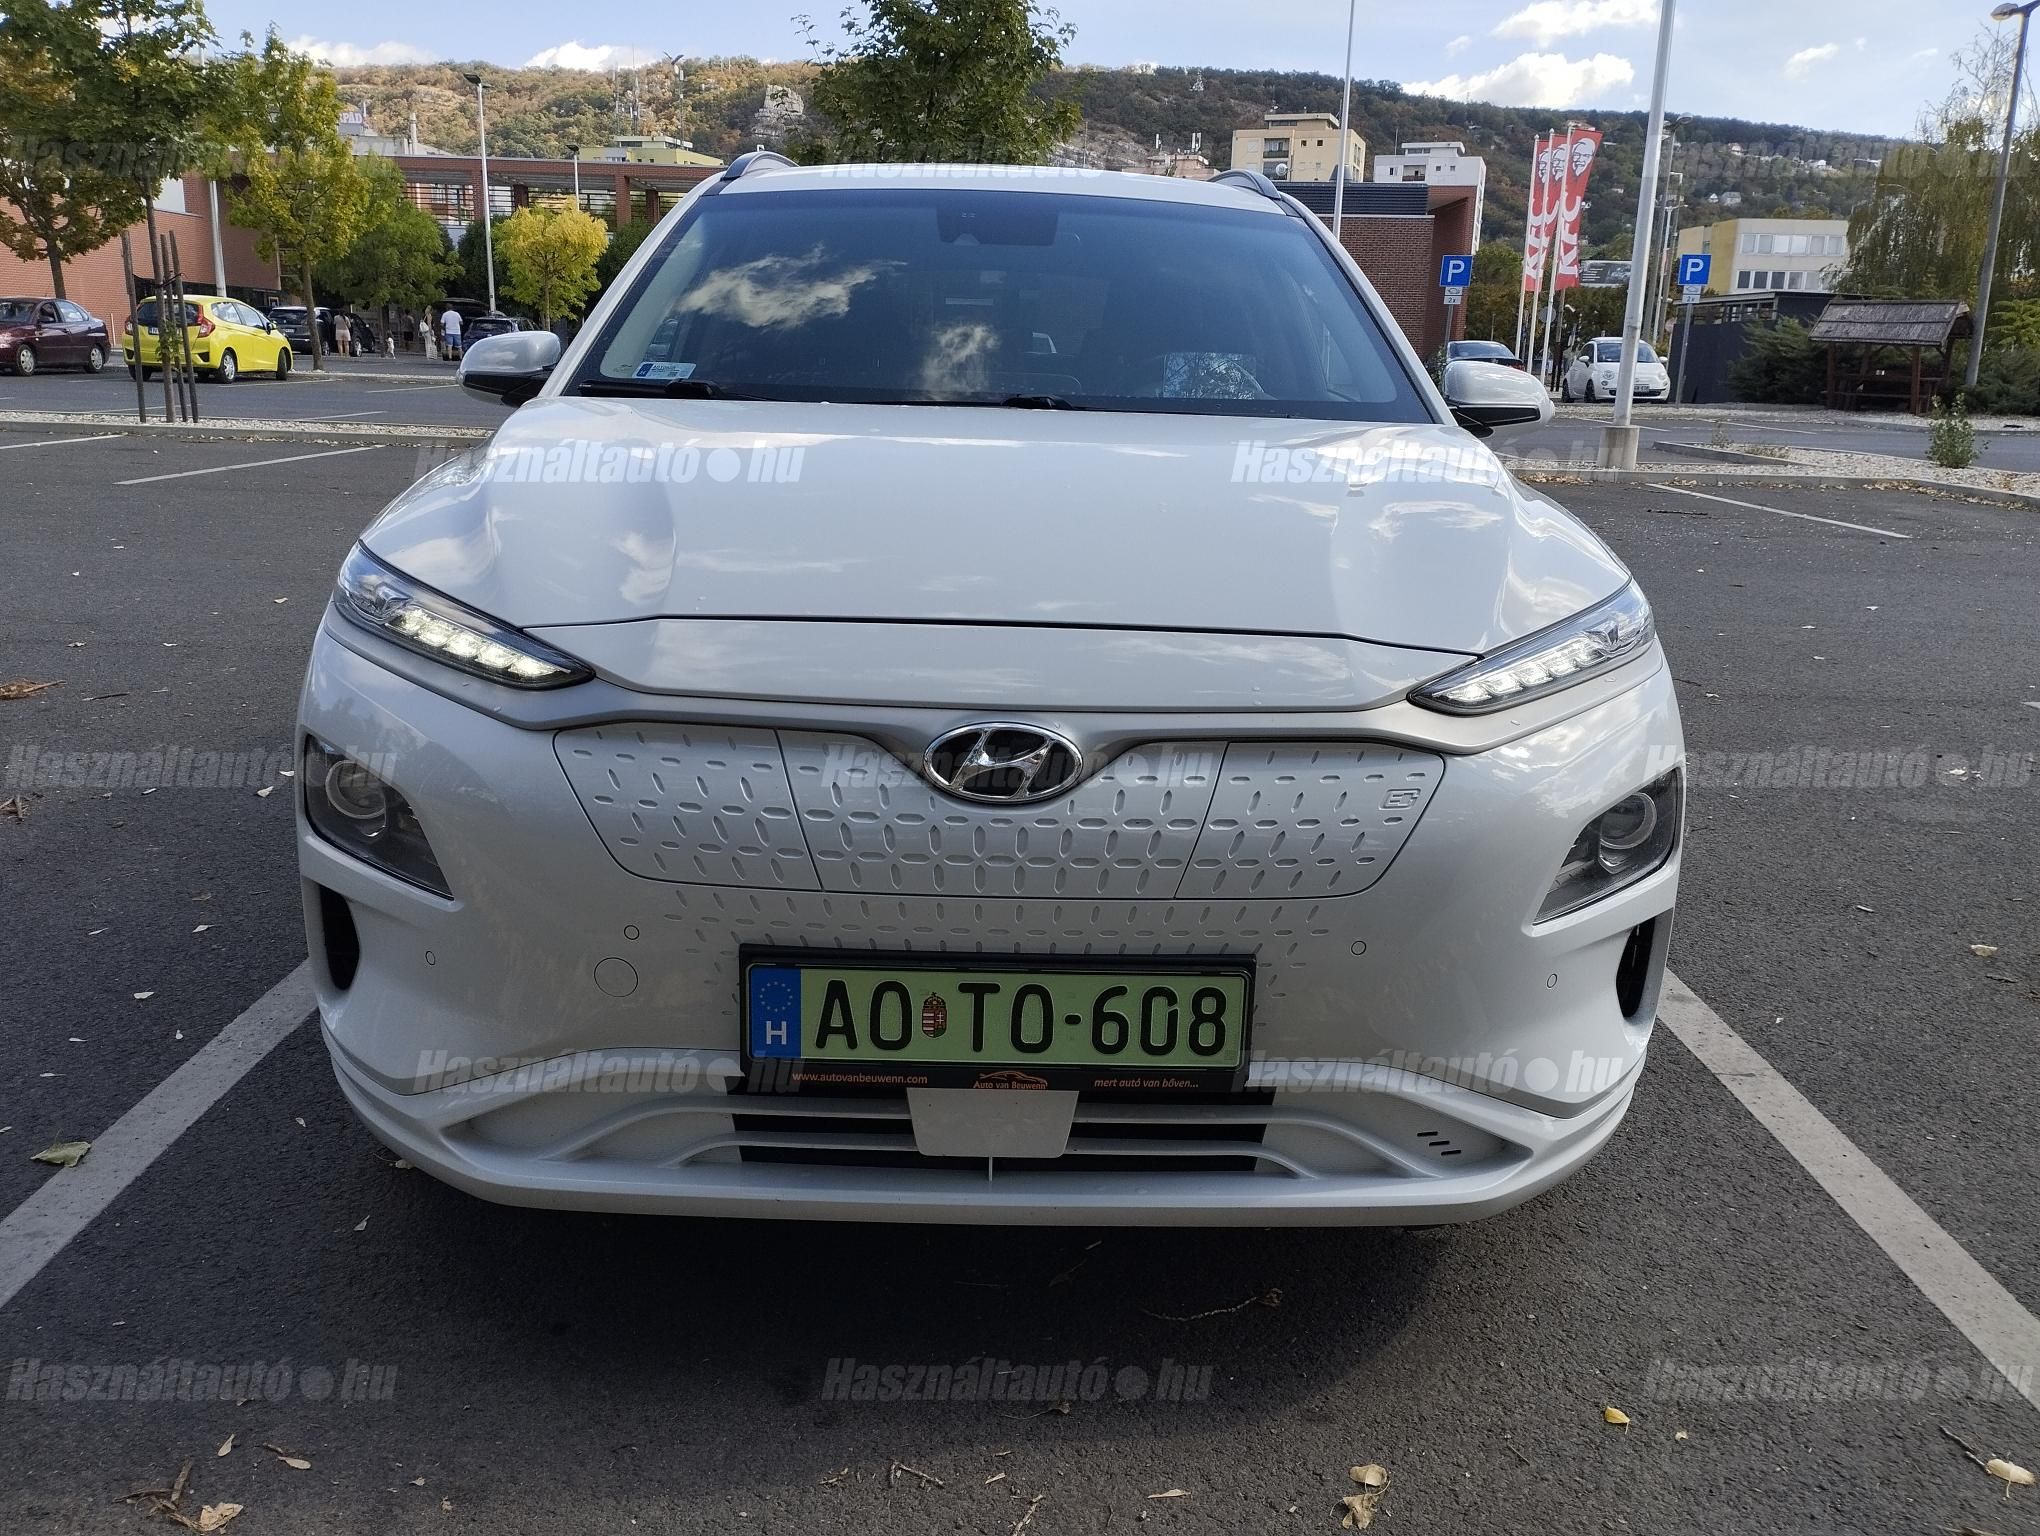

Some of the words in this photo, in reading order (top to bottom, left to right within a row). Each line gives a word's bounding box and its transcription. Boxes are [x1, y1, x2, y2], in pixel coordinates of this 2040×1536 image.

[1558, 191, 1582, 278] KFC
[1447, 260, 1465, 283] P
[1685, 258, 1704, 281] P
[815, 979, 914, 1051] AO
[765, 1020, 787, 1046] H
[792, 1072, 928, 1084] www.autovanbeuwenn.com
[973, 1080, 993, 1089] Auto
[1011, 1081, 1046, 1090] Beuwenn
[1094, 1079, 1117, 1088] mert
[1119, 1077, 1140, 1088] autó
[1143, 1079, 1160, 1088] van
